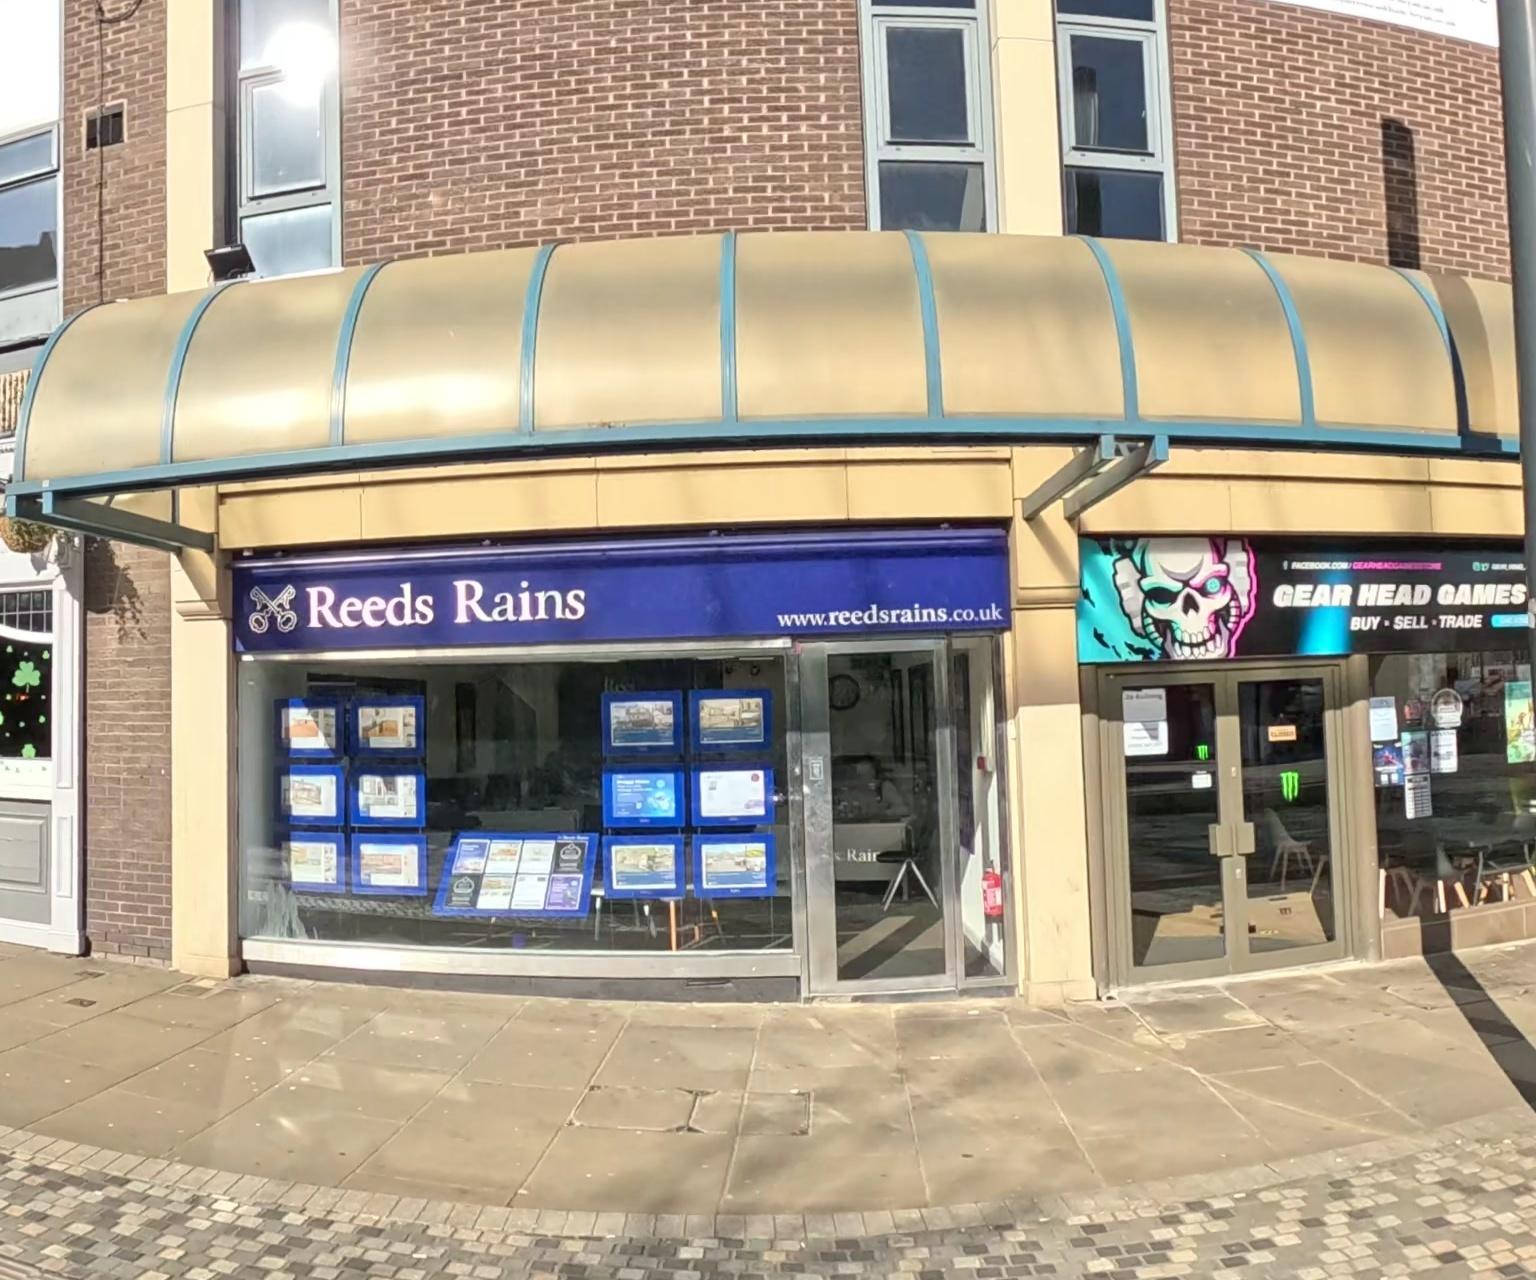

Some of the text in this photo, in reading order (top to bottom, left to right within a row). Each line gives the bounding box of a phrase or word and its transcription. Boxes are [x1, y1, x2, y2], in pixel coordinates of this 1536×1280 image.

[306, 580, 586, 628] Reeds Rains
[1273, 584, 1352, 607] GEAR
[1357, 584, 1432, 606] HEAD
[1437, 583, 1527, 606] GAMES
[777, 603, 1004, 628] www.reedsrains.co.uk
[1350, 616, 1380, 631] BUY
[1393, 615, 1428, 630] SELL
[1439, 614, 1484, 629] TRADE
